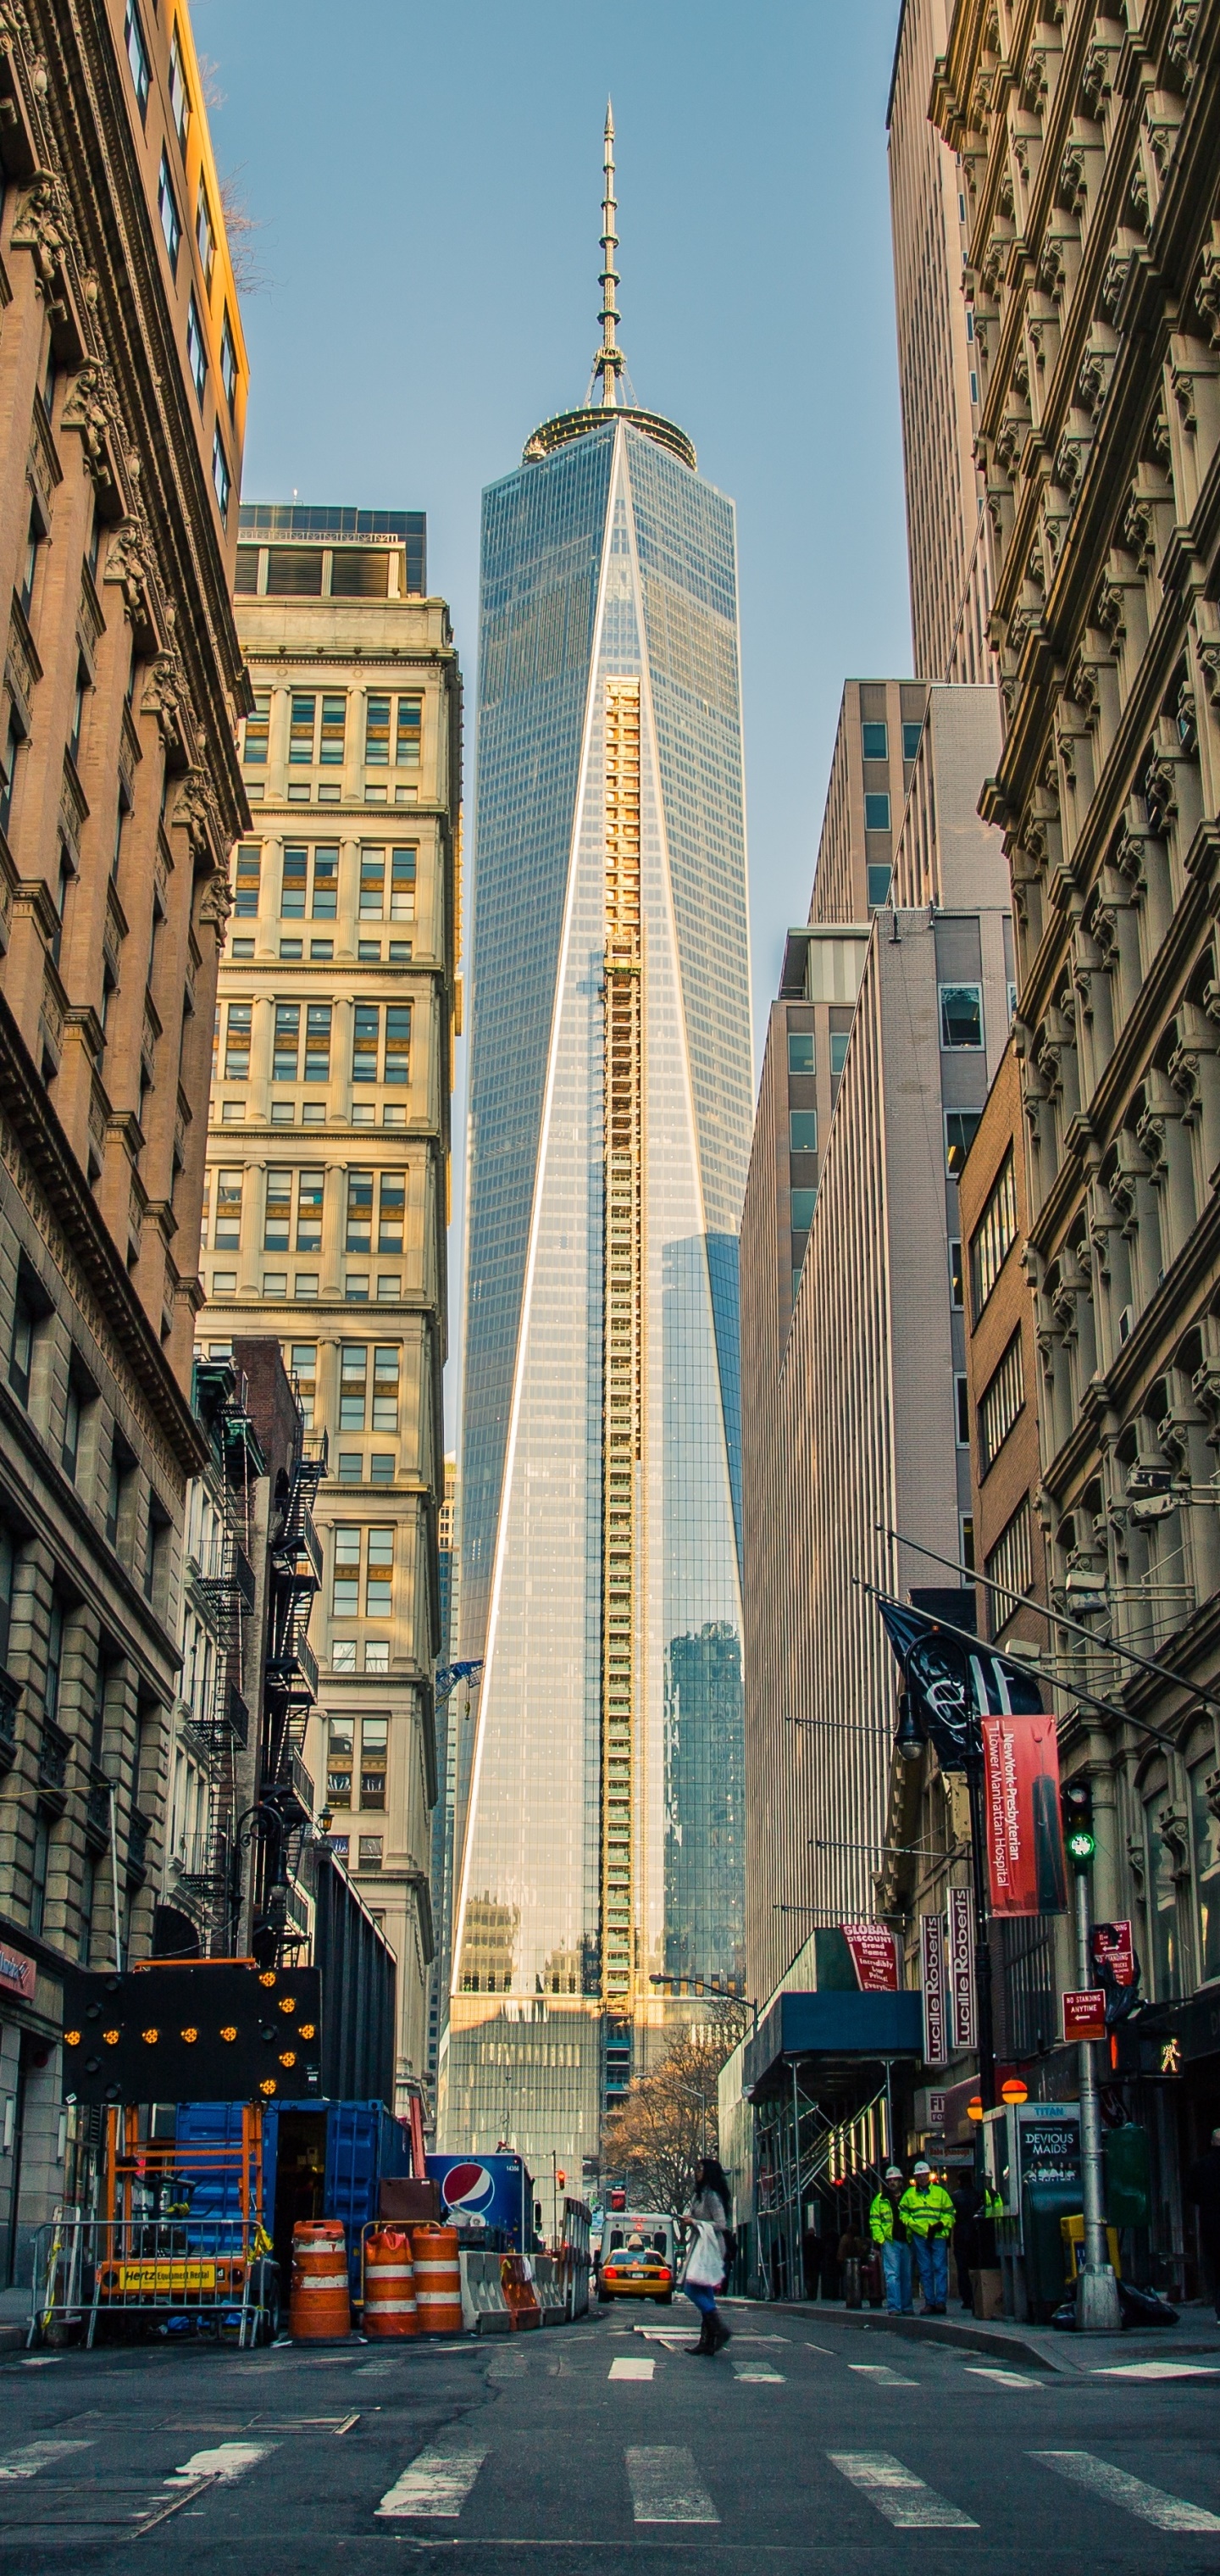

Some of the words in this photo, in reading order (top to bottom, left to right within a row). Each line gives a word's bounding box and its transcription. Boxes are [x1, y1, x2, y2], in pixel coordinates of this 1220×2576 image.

[989, 1734, 1000, 1768] Lower
[990, 1769, 1003, 1835] Manhattan
[1003, 1733, 1021, 1861] NewYork-Presbyterian
[994, 1838, 1009, 1887] Hospital
[843, 1924, 890, 1936] GLOBAL
[954, 1890, 968, 1974] Roberts
[859, 1957, 894, 1970] Incredibly
[925, 1917, 939, 1995] Roberts
[1071, 2004, 1098, 2013] ANYTIME
[1076, 1994, 1101, 2003] STANDING
[958, 1976, 970, 2046] Lucille
[929, 1998, 941, 2062] Lucille
[1034, 2107, 1064, 2116] TITAN
[1025, 2133, 1073, 2145] DEVIOUS
[1033, 2144, 1068, 2155] MAIDS
[125, 2270, 155, 2281] Hertz
